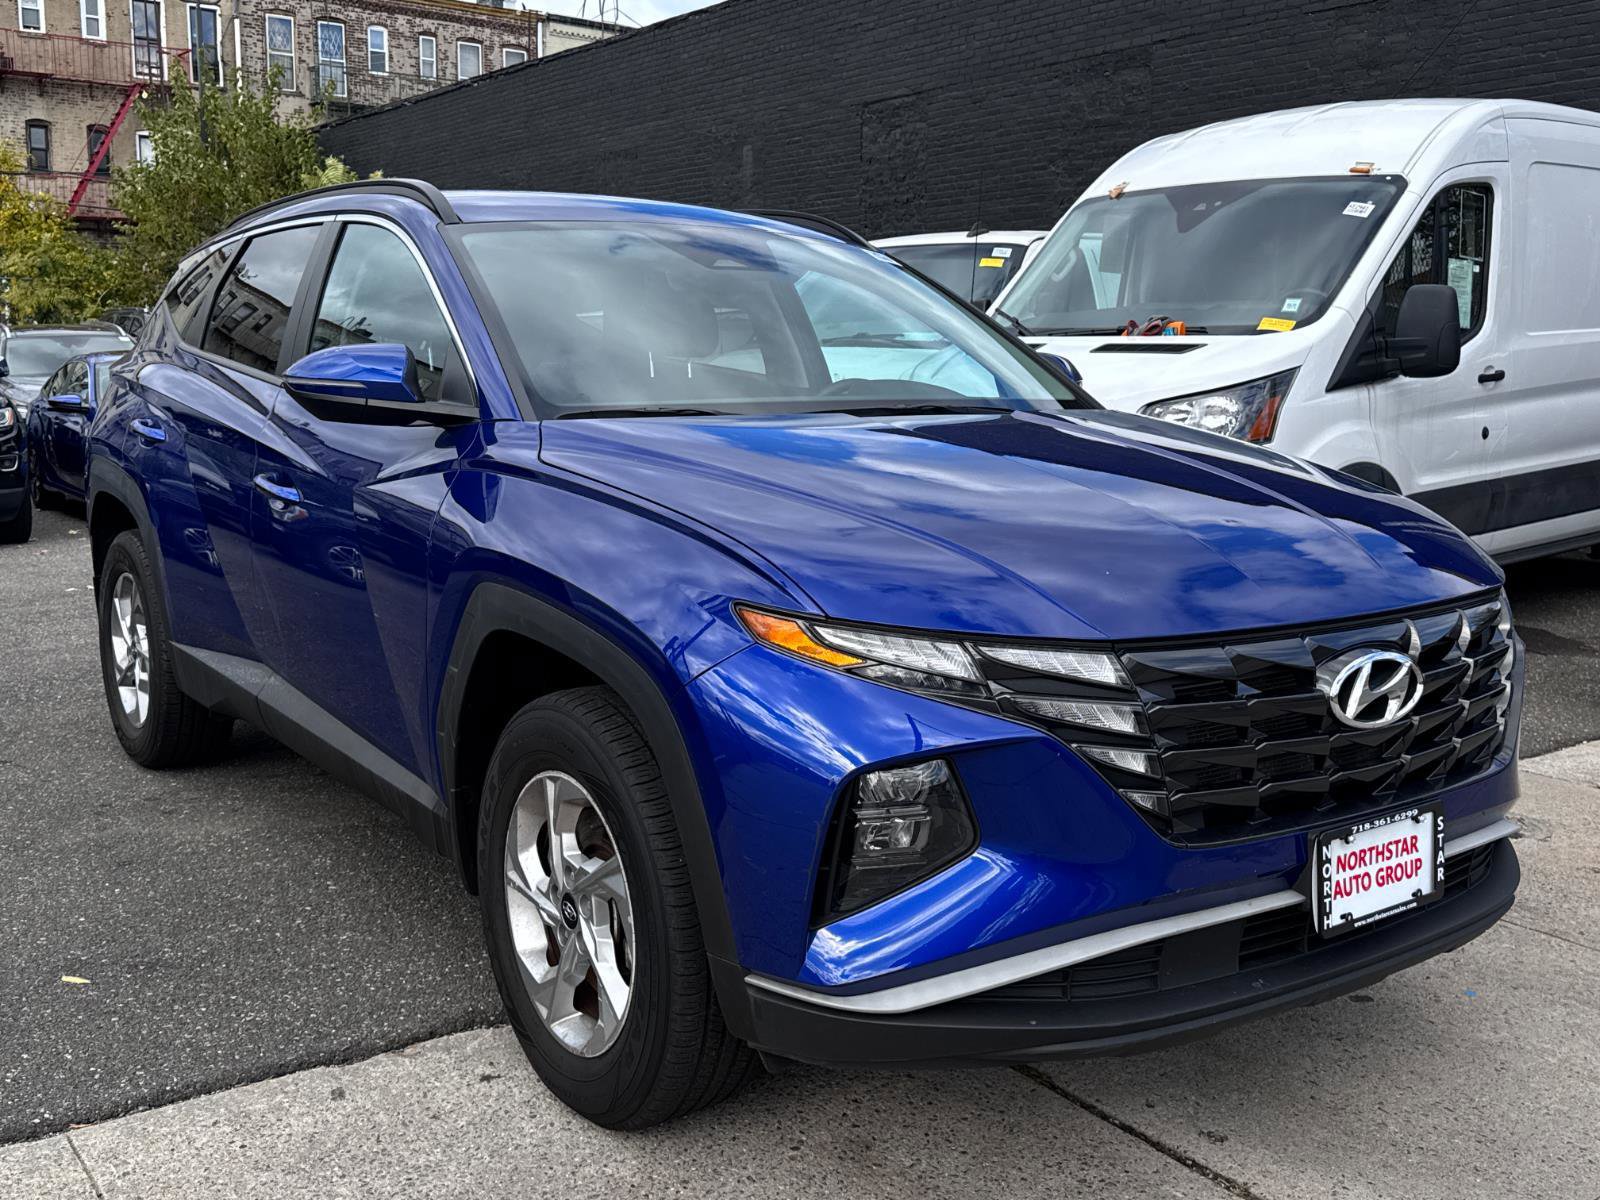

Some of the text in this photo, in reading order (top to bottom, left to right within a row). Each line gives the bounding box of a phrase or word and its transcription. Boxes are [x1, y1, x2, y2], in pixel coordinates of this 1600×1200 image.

[1351, 809, 1418, 834] 718-361-6299
[1336, 835, 1419, 875] NORTHSTAR
[1437, 816, 1445, 881] STAR
[1333, 857, 1423, 900] AUTO GROUP
